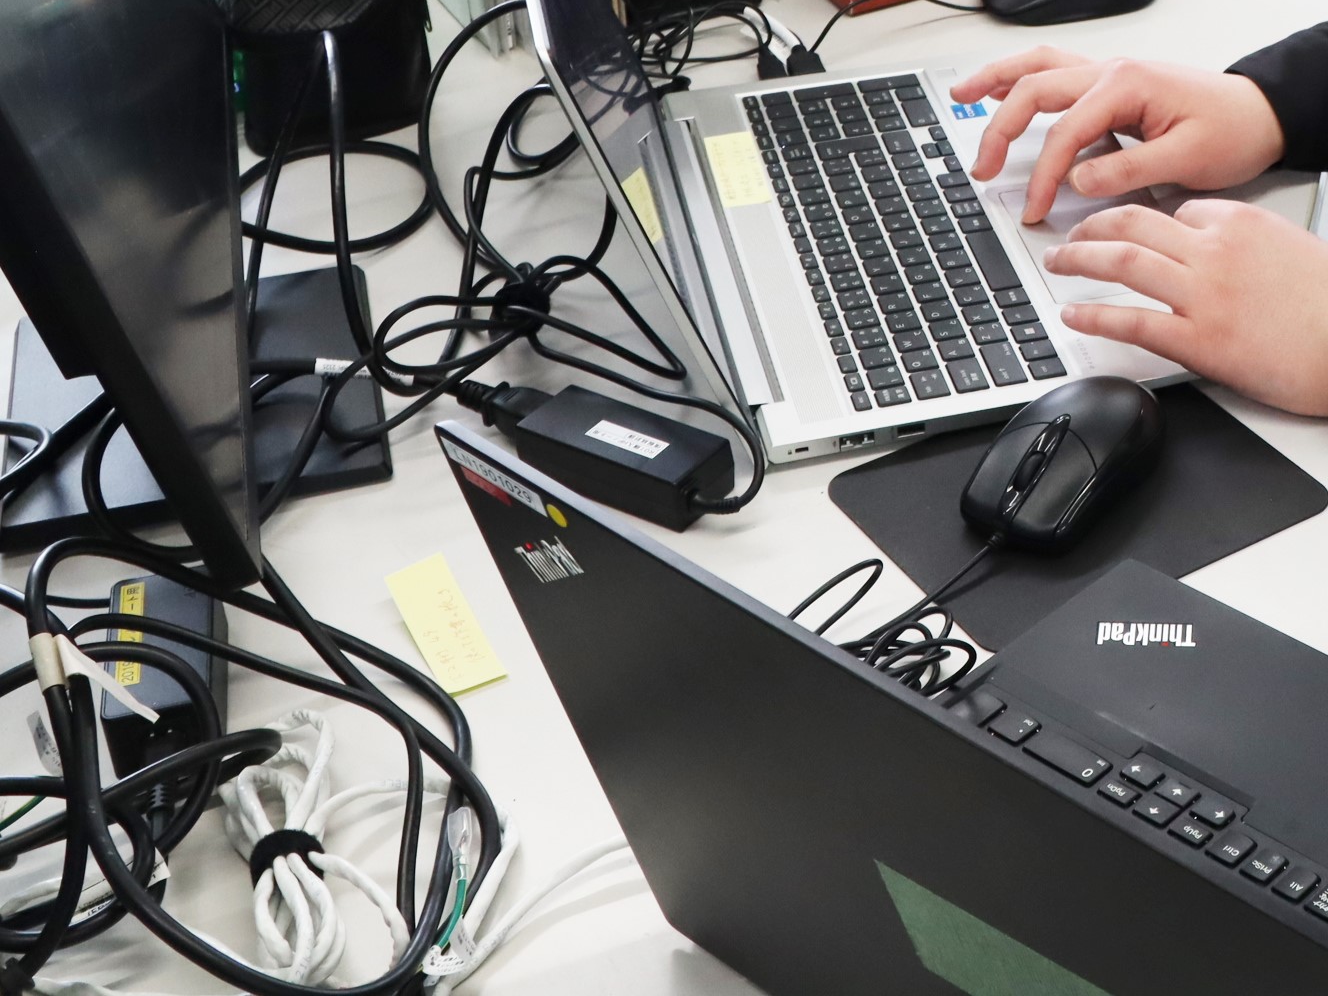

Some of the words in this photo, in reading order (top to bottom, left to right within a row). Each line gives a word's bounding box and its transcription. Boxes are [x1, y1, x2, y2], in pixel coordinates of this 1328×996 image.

[454, 447, 532, 504] LN1901029
[514, 535, 584, 583] ThinkPad
[1096, 620, 1197, 647] ThinkPad
[1106, 783, 1126, 797] PgDn
[1183, 824, 1203, 840] PgUp
[1222, 845, 1240, 857] Ctrl
[1251, 859, 1273, 875] PrtSc
[1289, 881, 1304, 892] Alt
